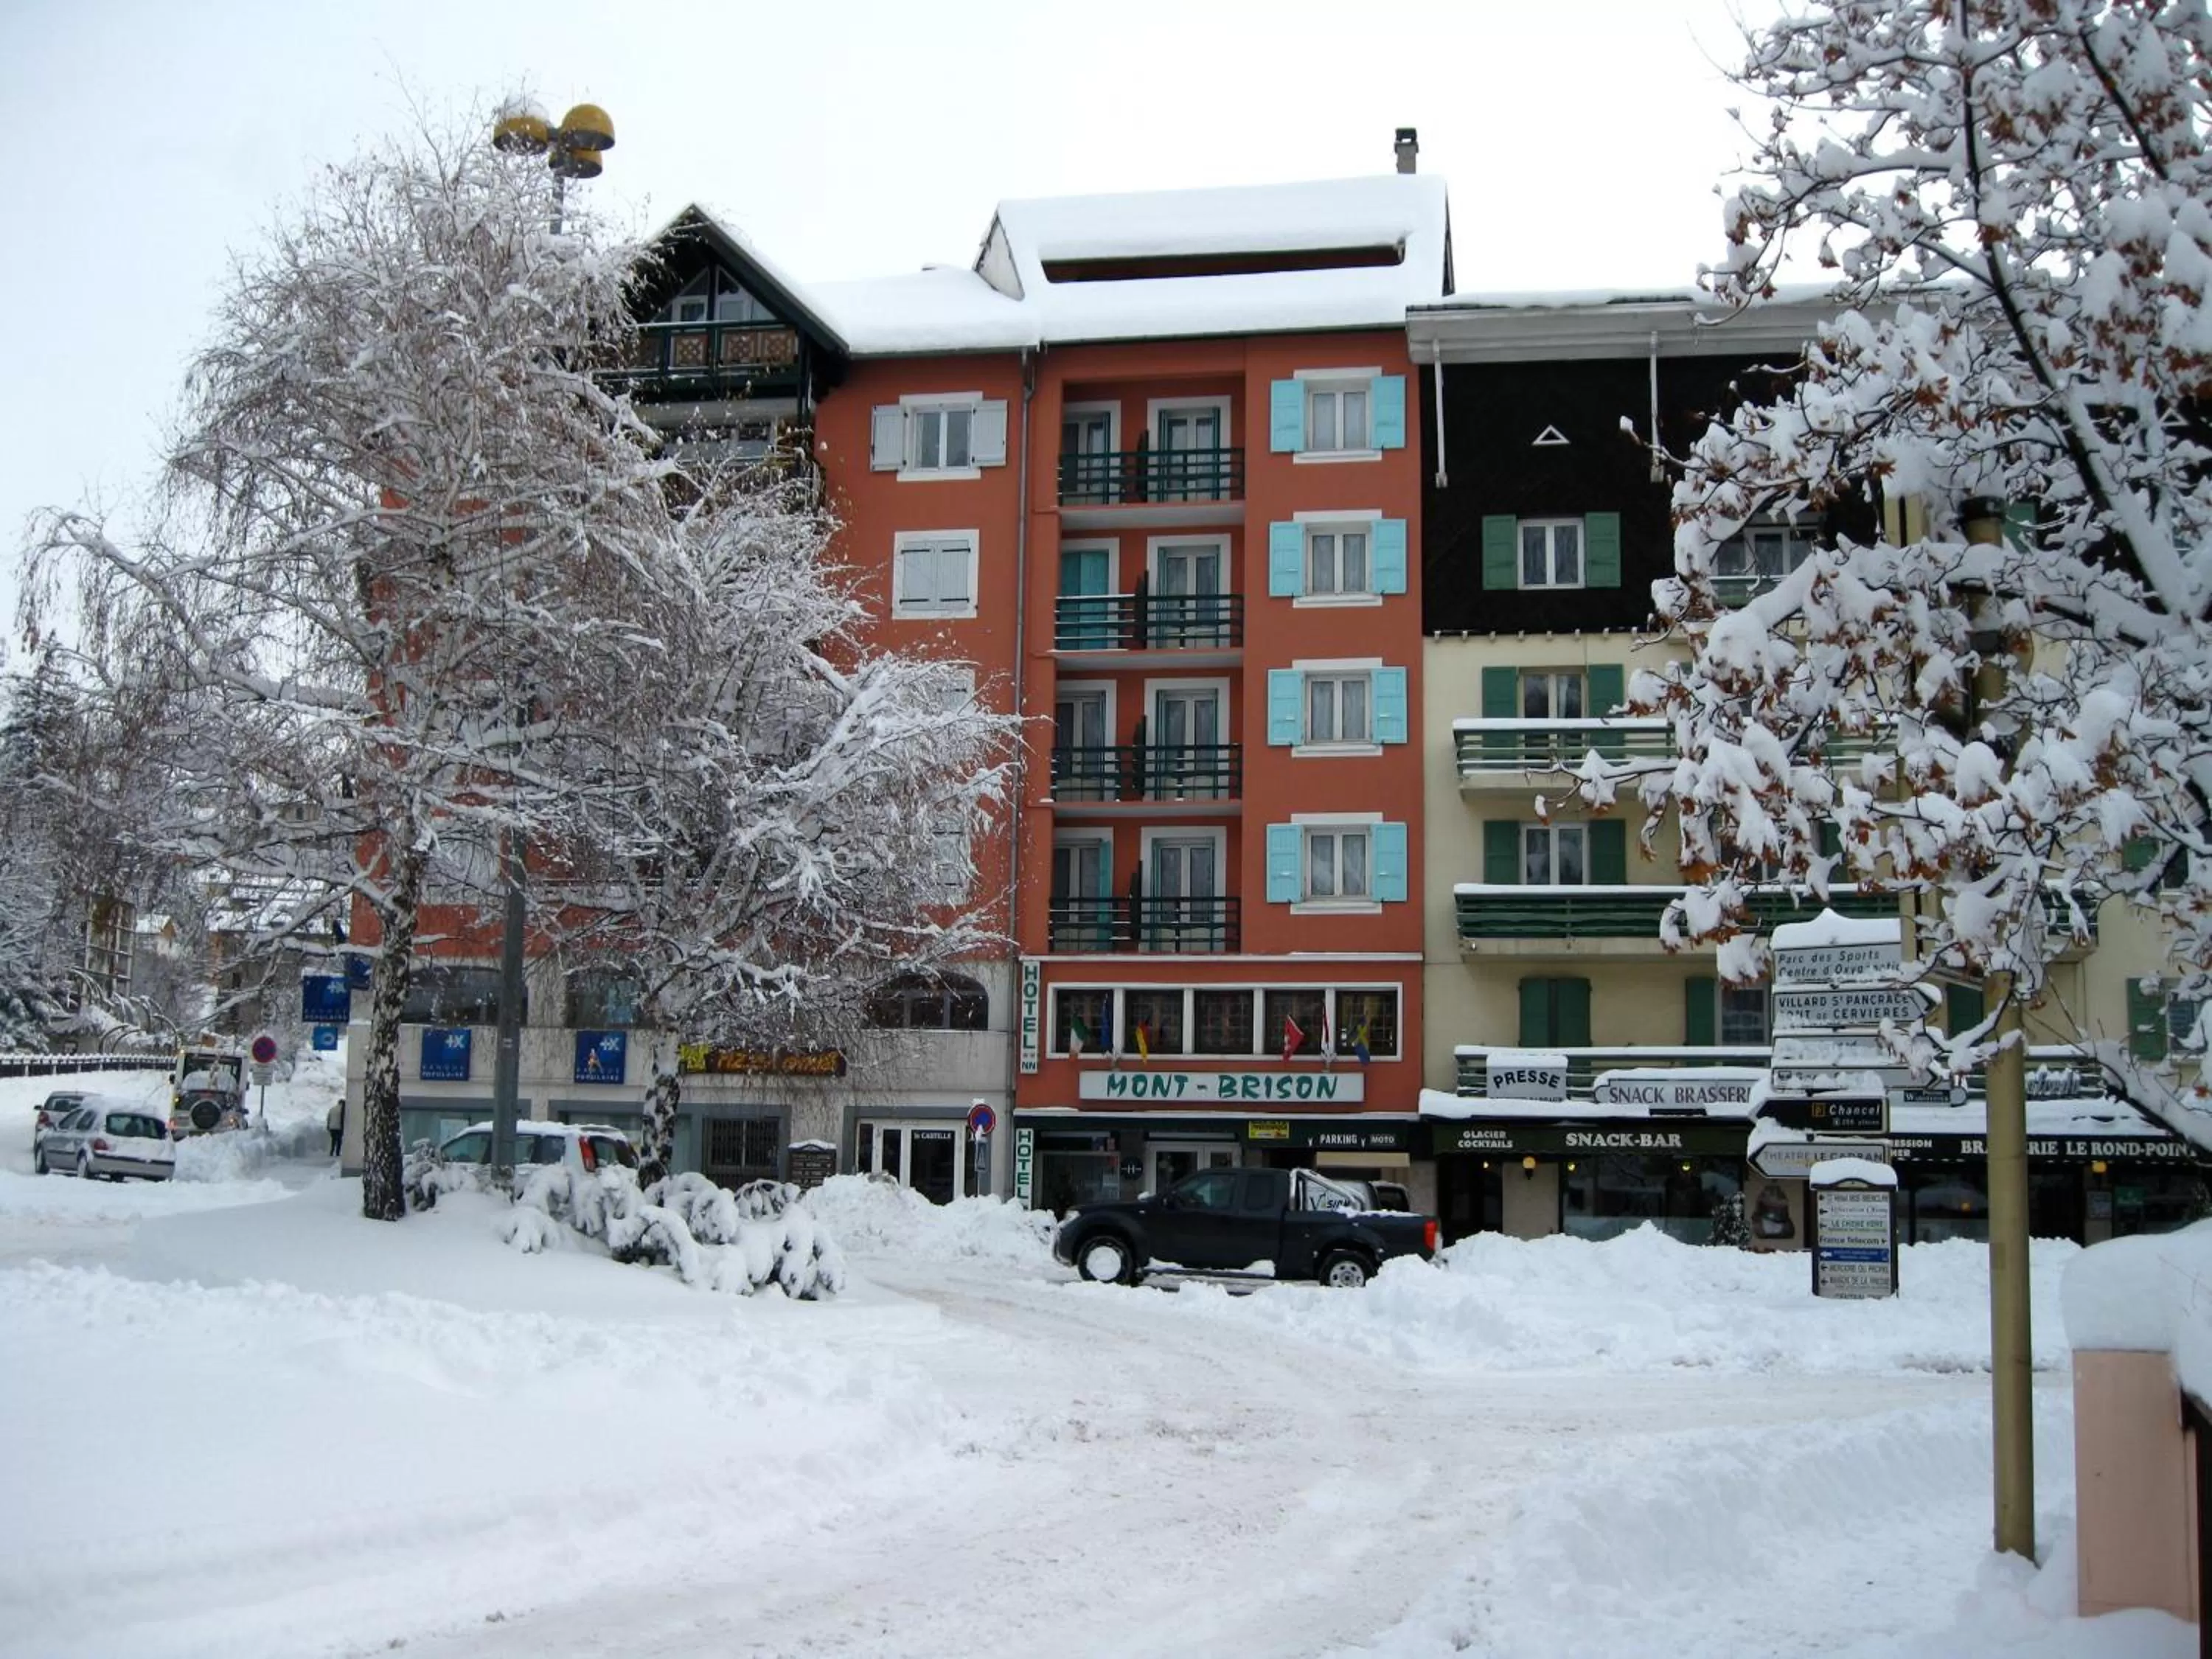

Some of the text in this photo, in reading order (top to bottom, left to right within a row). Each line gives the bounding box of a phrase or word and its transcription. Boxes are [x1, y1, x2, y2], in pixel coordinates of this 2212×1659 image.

[1778, 950, 1879, 964] Parc des Sports
[1023, 965, 1037, 1049] HOTEL
[1779, 996, 1826, 1007] VILLARD
[1846, 994, 1909, 1005] PANCRACE
[1833, 1007, 1909, 1019] CERVIERES
[1107, 1074, 1189, 1098] MONT
[1218, 1074, 1338, 1099] BRISON
[1493, 1070, 1560, 1089] PRESSE
[1610, 1087, 1751, 1104] SNACK BRASSERI
[1829, 1104, 1880, 1116] Chancel
[1320, 1134, 1395, 1144] PARKING MOTO
[1463, 1130, 1506, 1139] GLACIER
[1565, 1133, 1682, 1147] SNACK-BAR
[1458, 1140, 1513, 1148] COCKTAILS
[1961, 1139, 2059, 1155] BRRIE
[2066, 1141, 2087, 1155] LE
[1017, 1130, 1032, 1199] HOTEL
